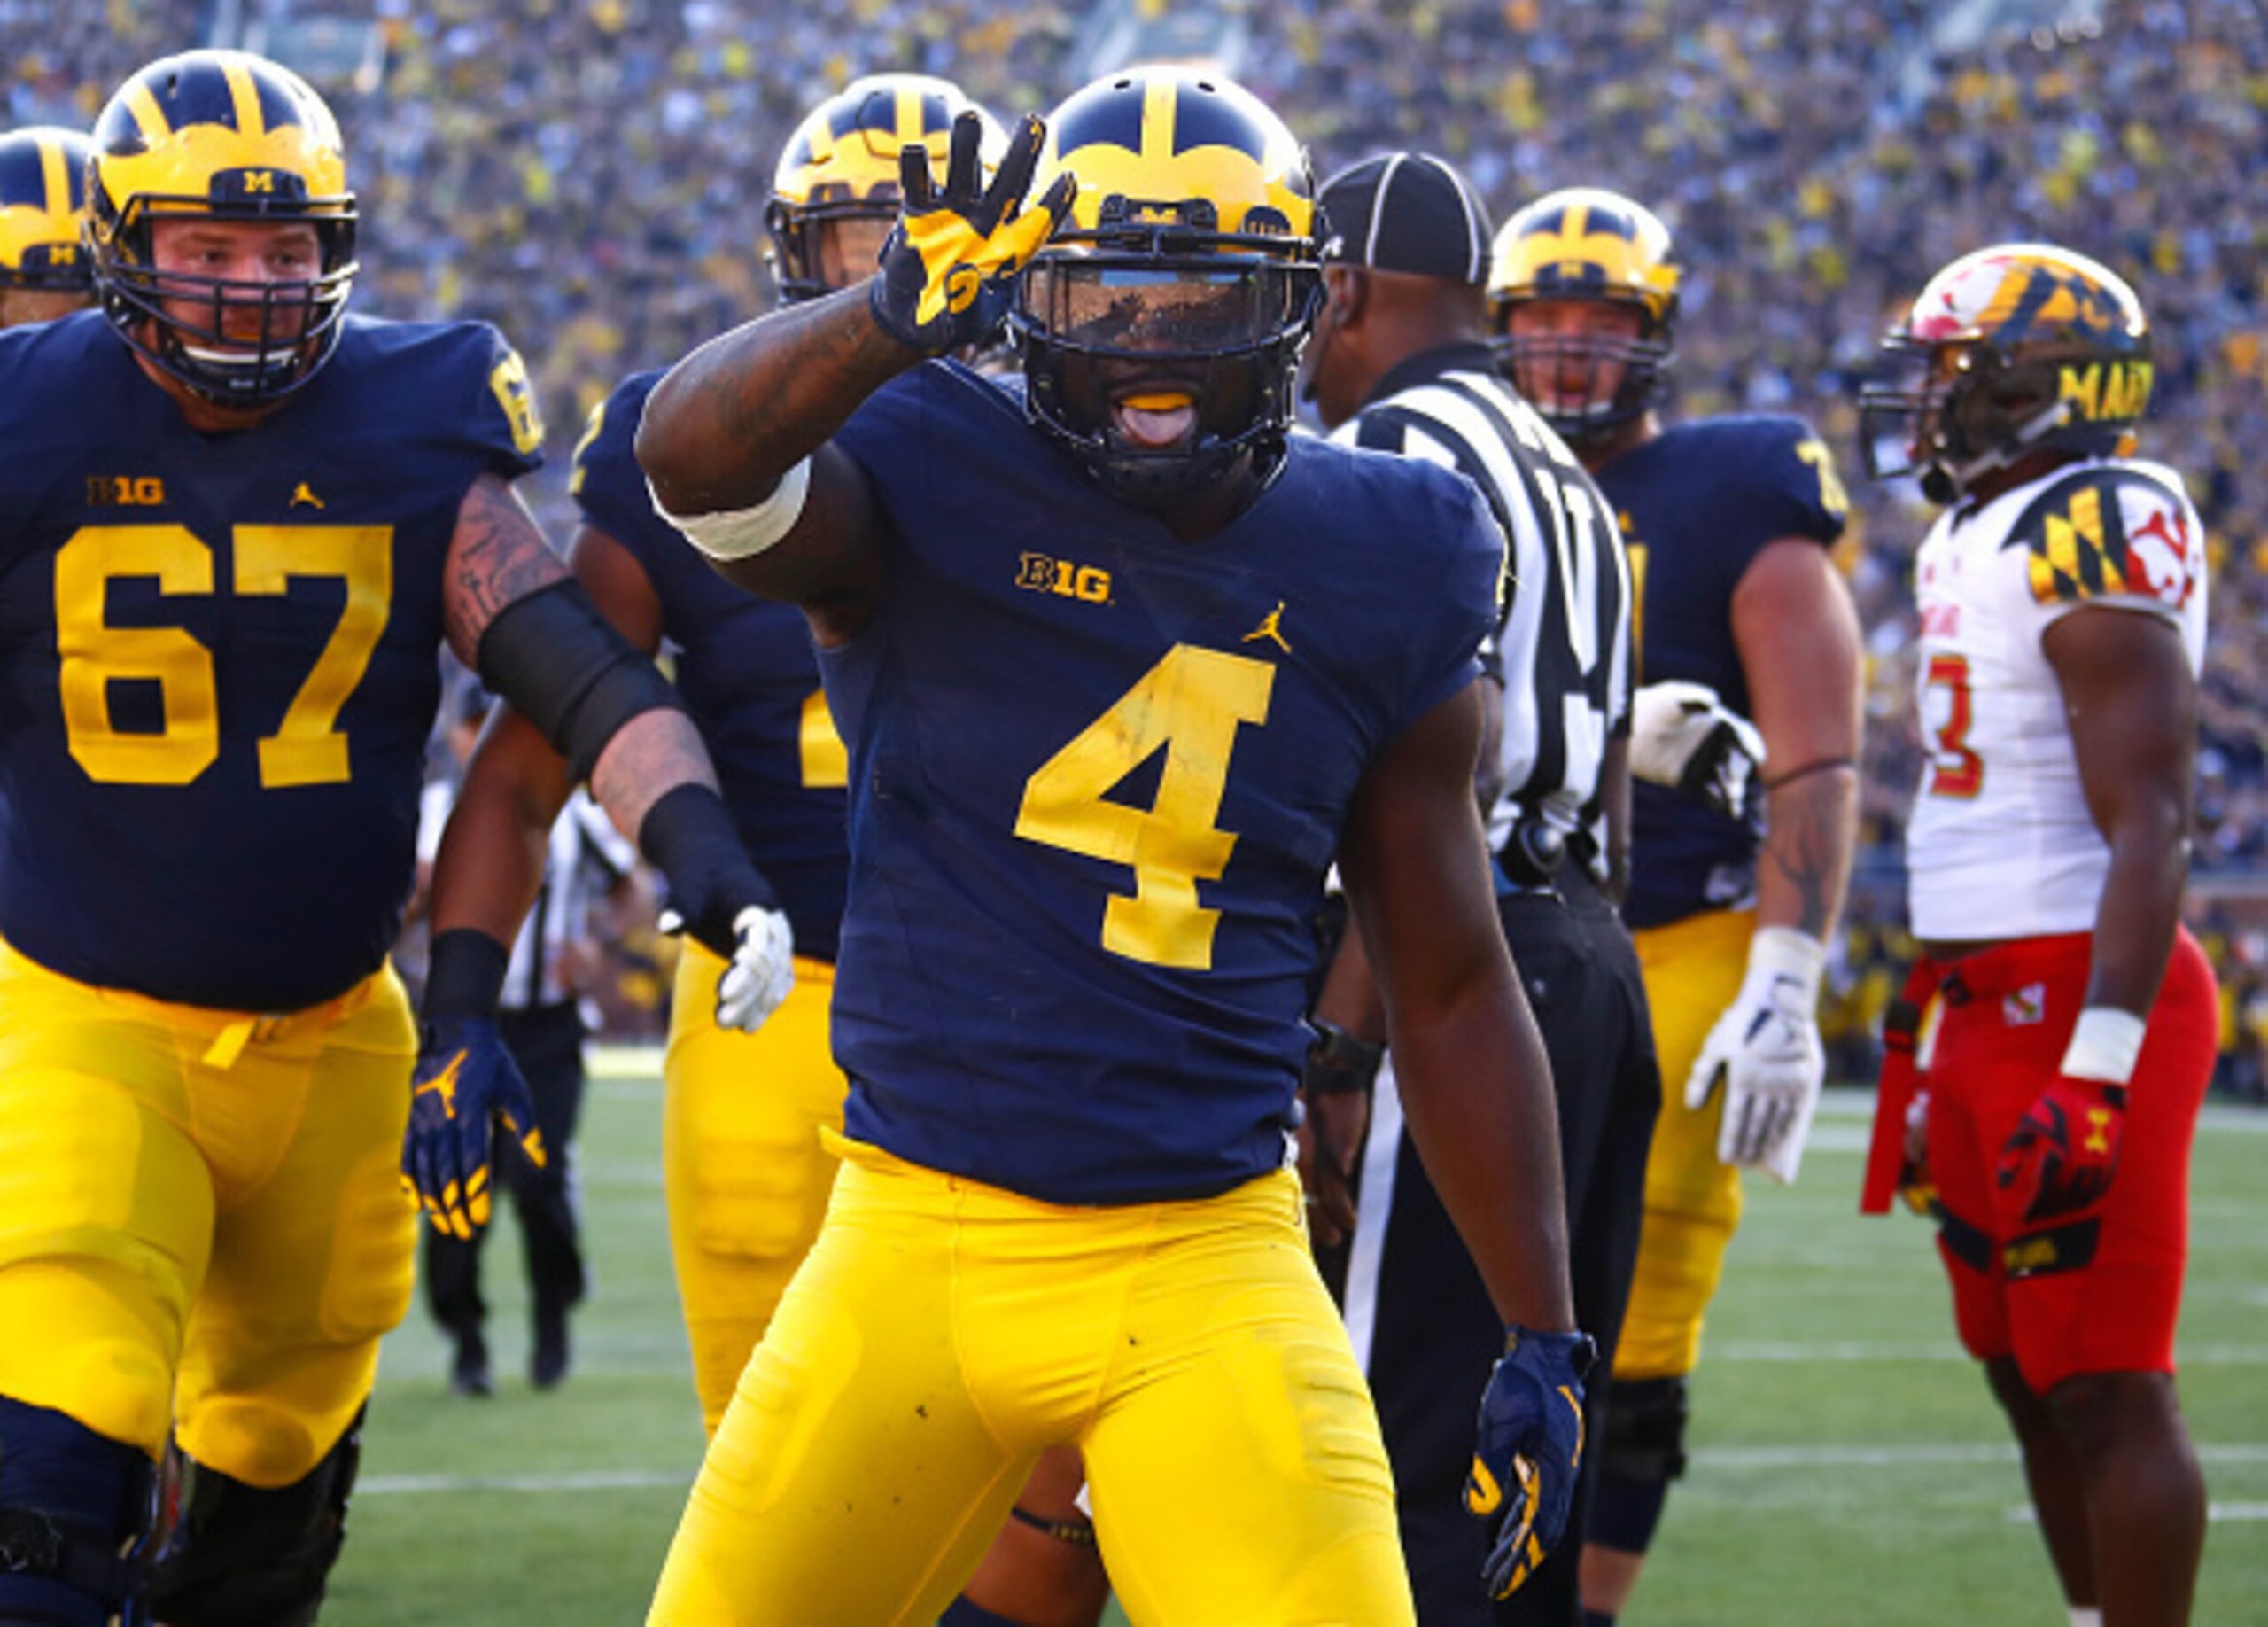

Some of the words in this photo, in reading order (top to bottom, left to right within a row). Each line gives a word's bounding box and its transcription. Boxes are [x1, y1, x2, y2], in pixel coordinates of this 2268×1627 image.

[244, 171, 275, 192] M
[55, 524, 394, 789] 67
[1014, 642, 1276, 970] 4
